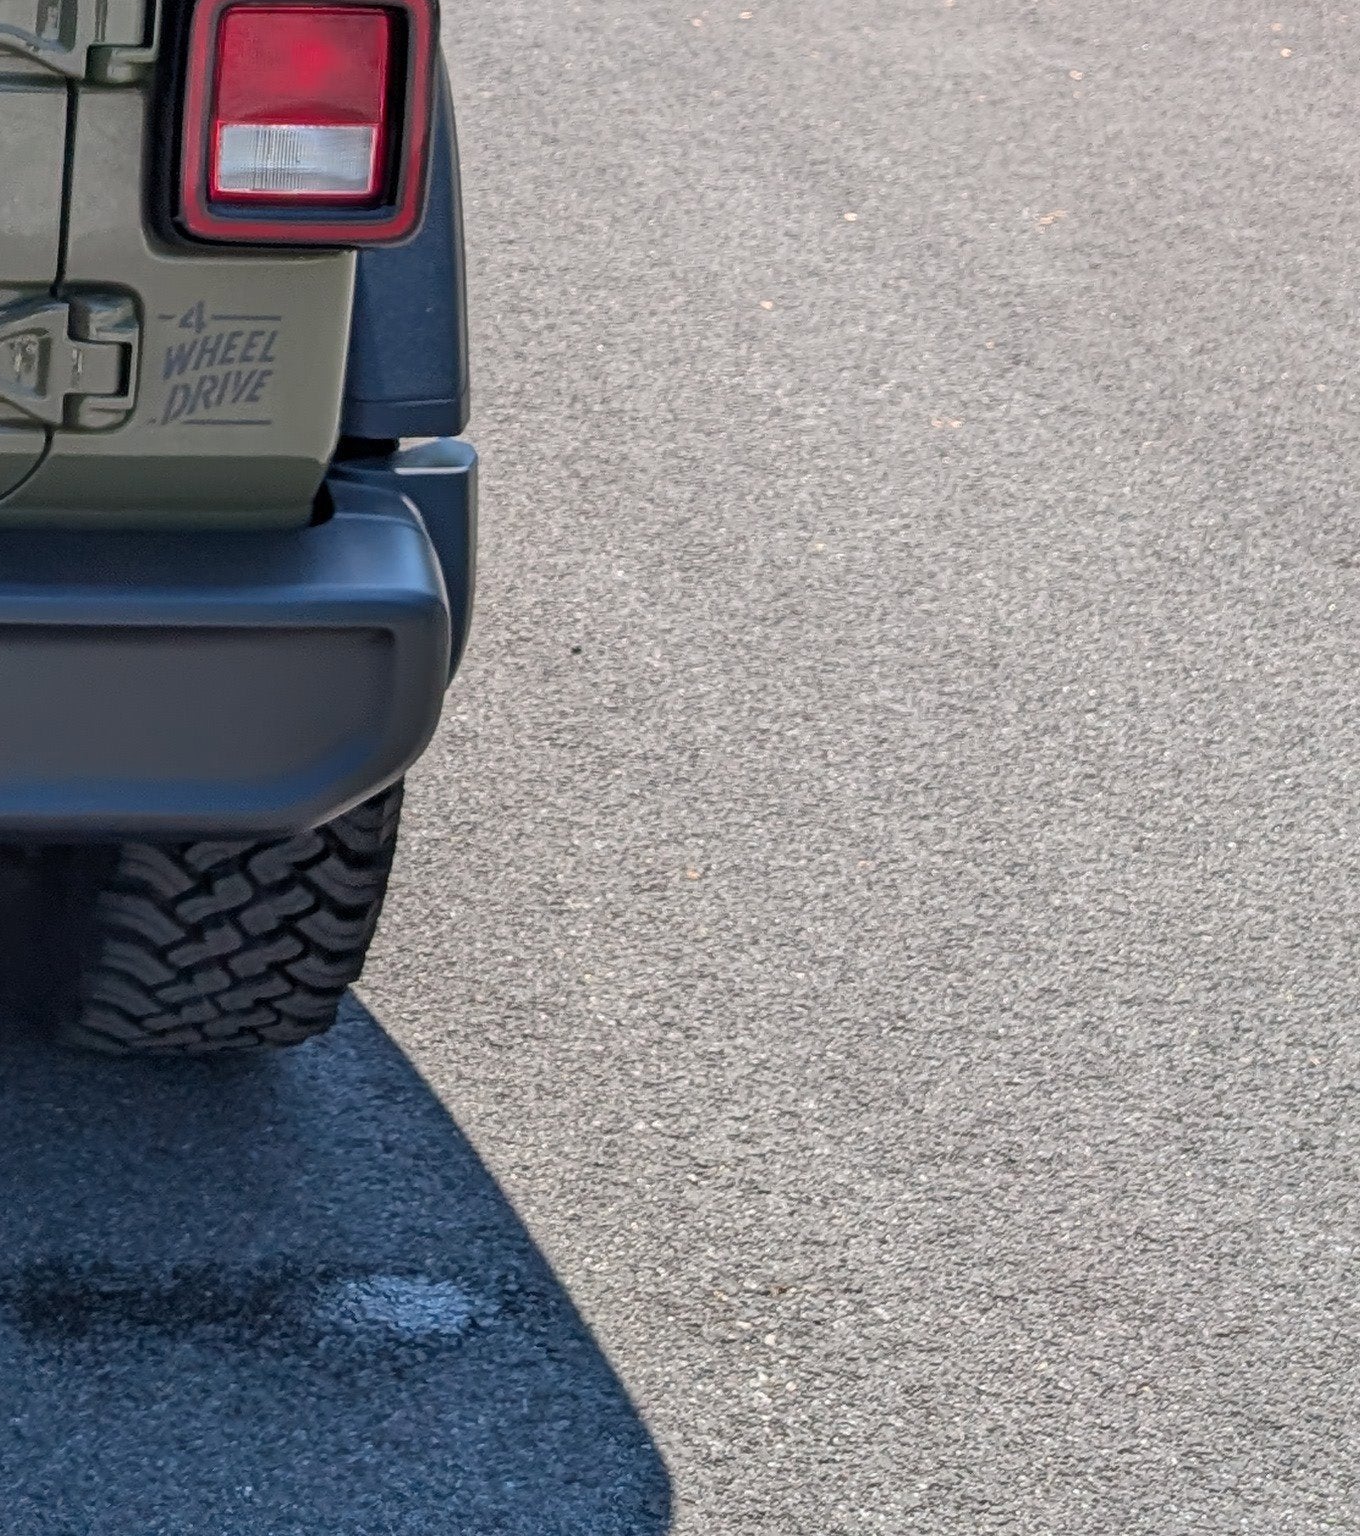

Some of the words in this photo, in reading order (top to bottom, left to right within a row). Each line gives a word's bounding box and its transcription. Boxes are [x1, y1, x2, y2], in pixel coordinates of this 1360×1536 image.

[178, 299, 208, 334] 4
[163, 330, 278, 380] WHEEL
[160, 369, 274, 425] DRIVE
